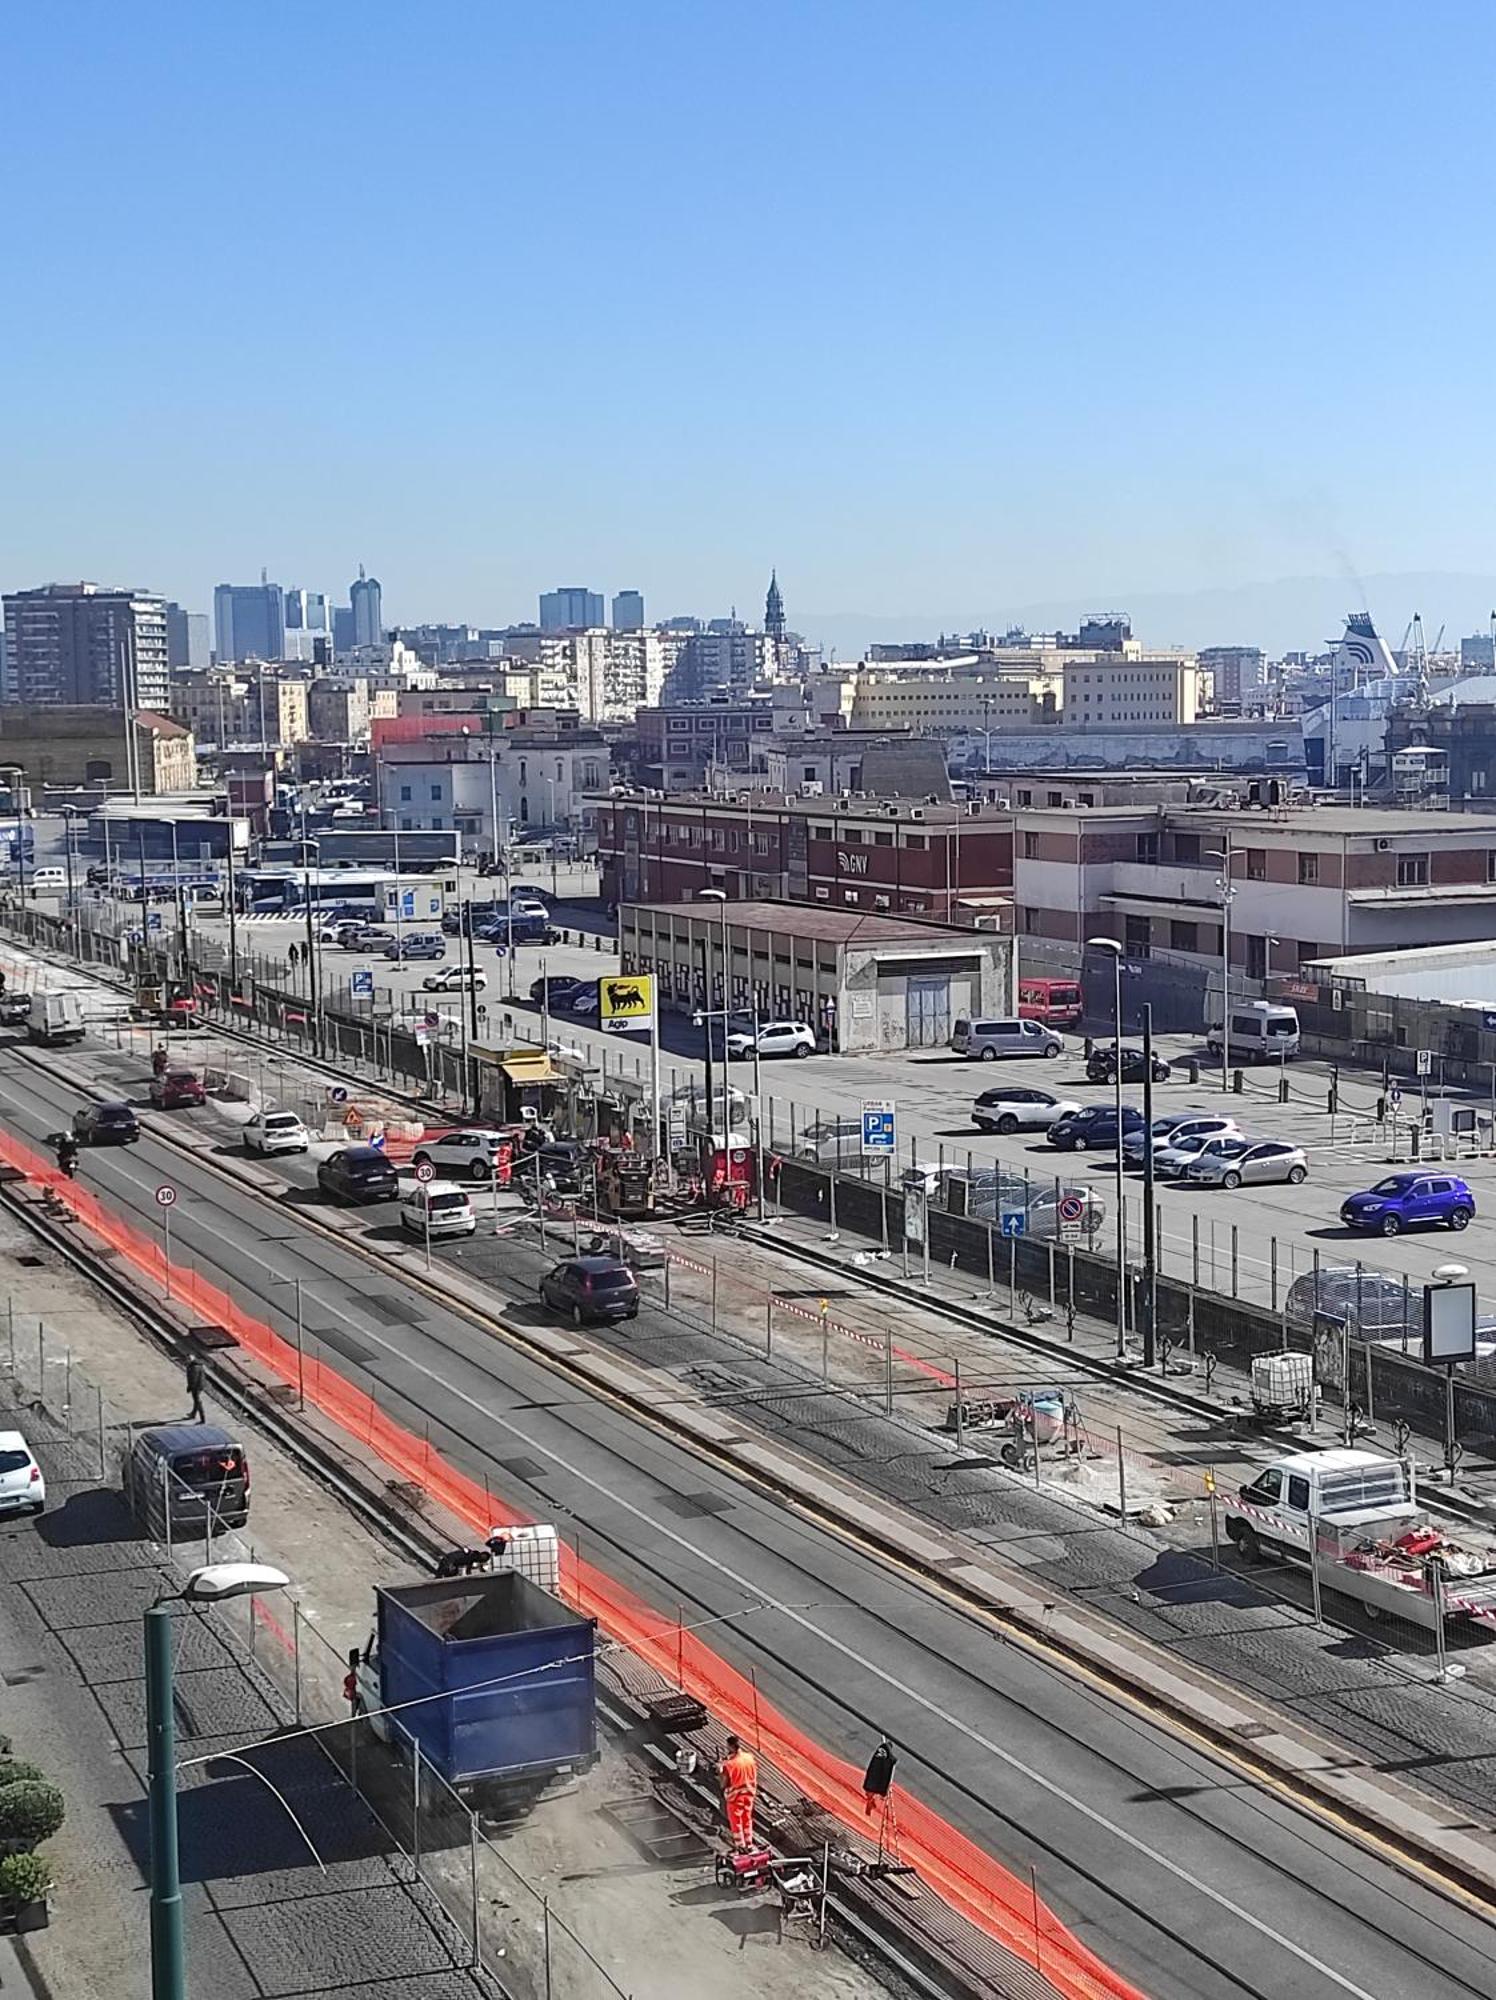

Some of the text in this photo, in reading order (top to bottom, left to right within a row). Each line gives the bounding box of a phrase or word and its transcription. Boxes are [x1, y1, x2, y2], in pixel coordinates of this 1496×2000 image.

[850, 854, 868, 874] GNV
[608, 1020, 629, 1029] Agip
[868, 1116, 879, 1130] P
[420, 1167, 431, 1178] 30
[160, 1191, 172, 1201] 30
